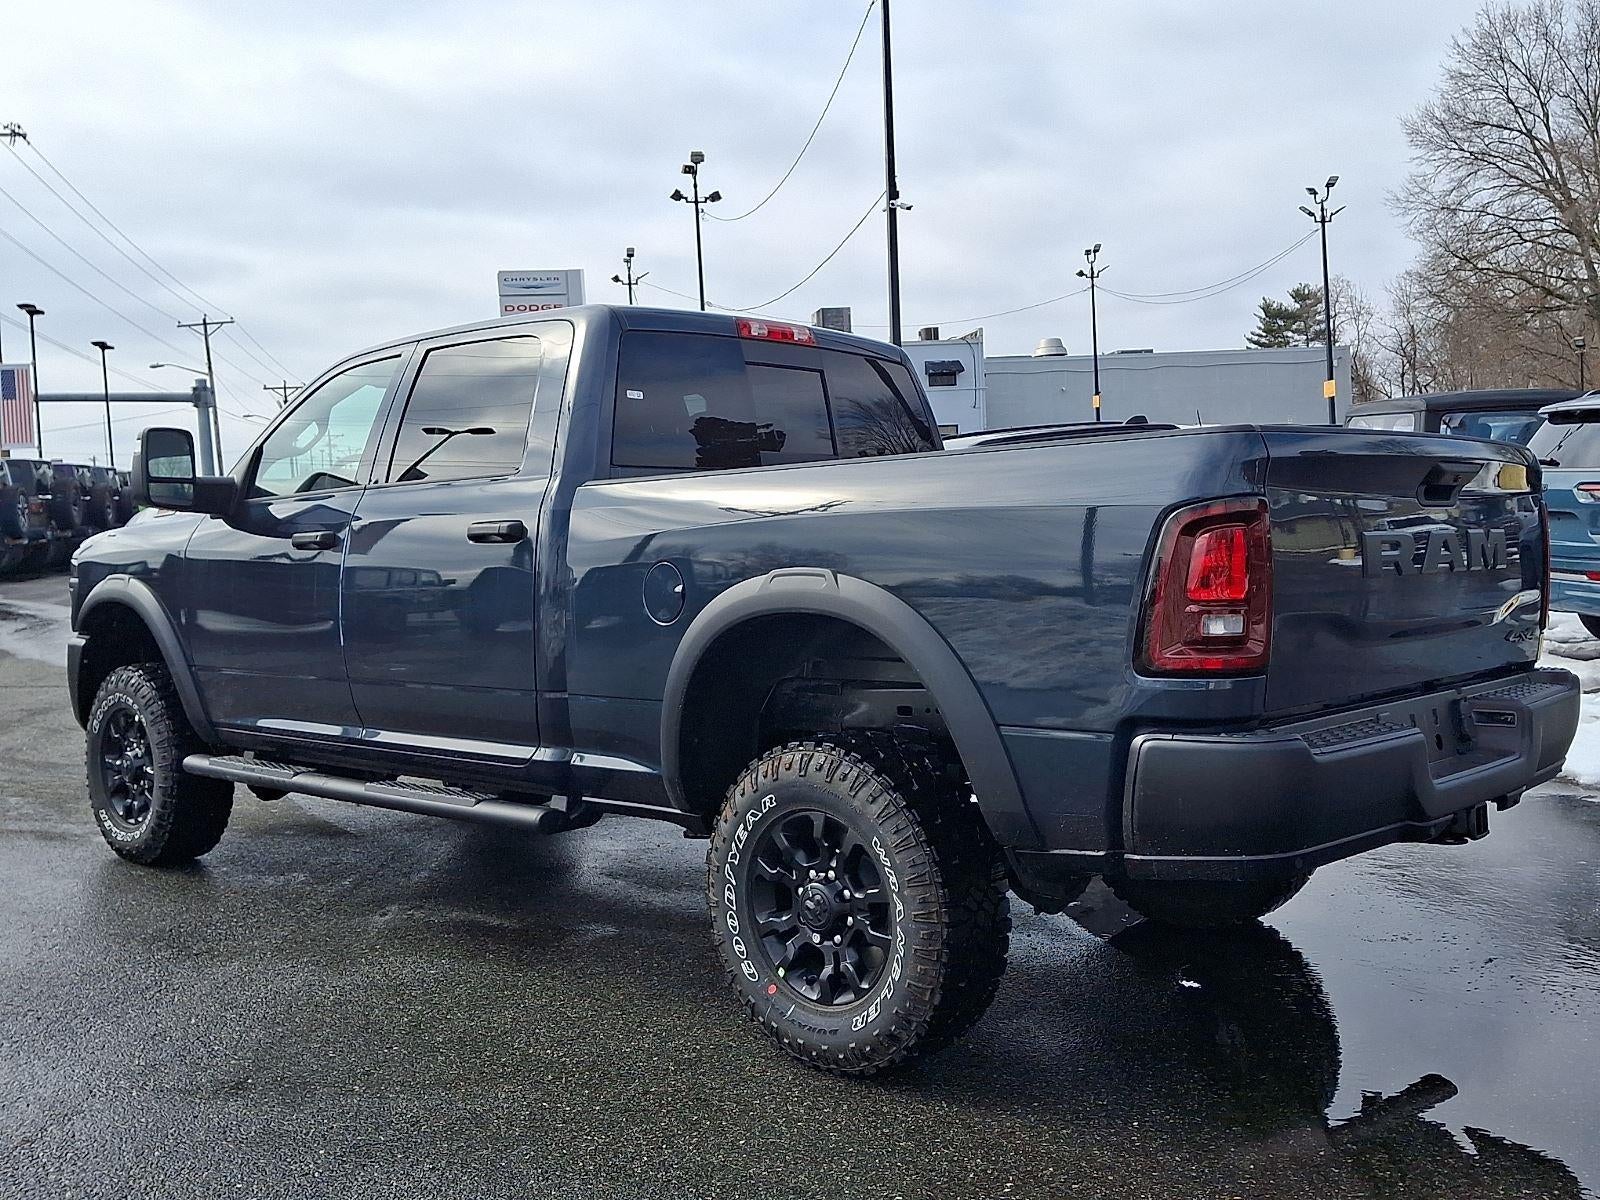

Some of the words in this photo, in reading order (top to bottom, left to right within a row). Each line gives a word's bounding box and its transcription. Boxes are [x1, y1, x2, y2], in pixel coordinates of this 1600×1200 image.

[1361, 528, 1508, 577] RAM
[724, 793, 777, 981] GOODYEAR
[851, 836, 906, 1032] WRANGLER
